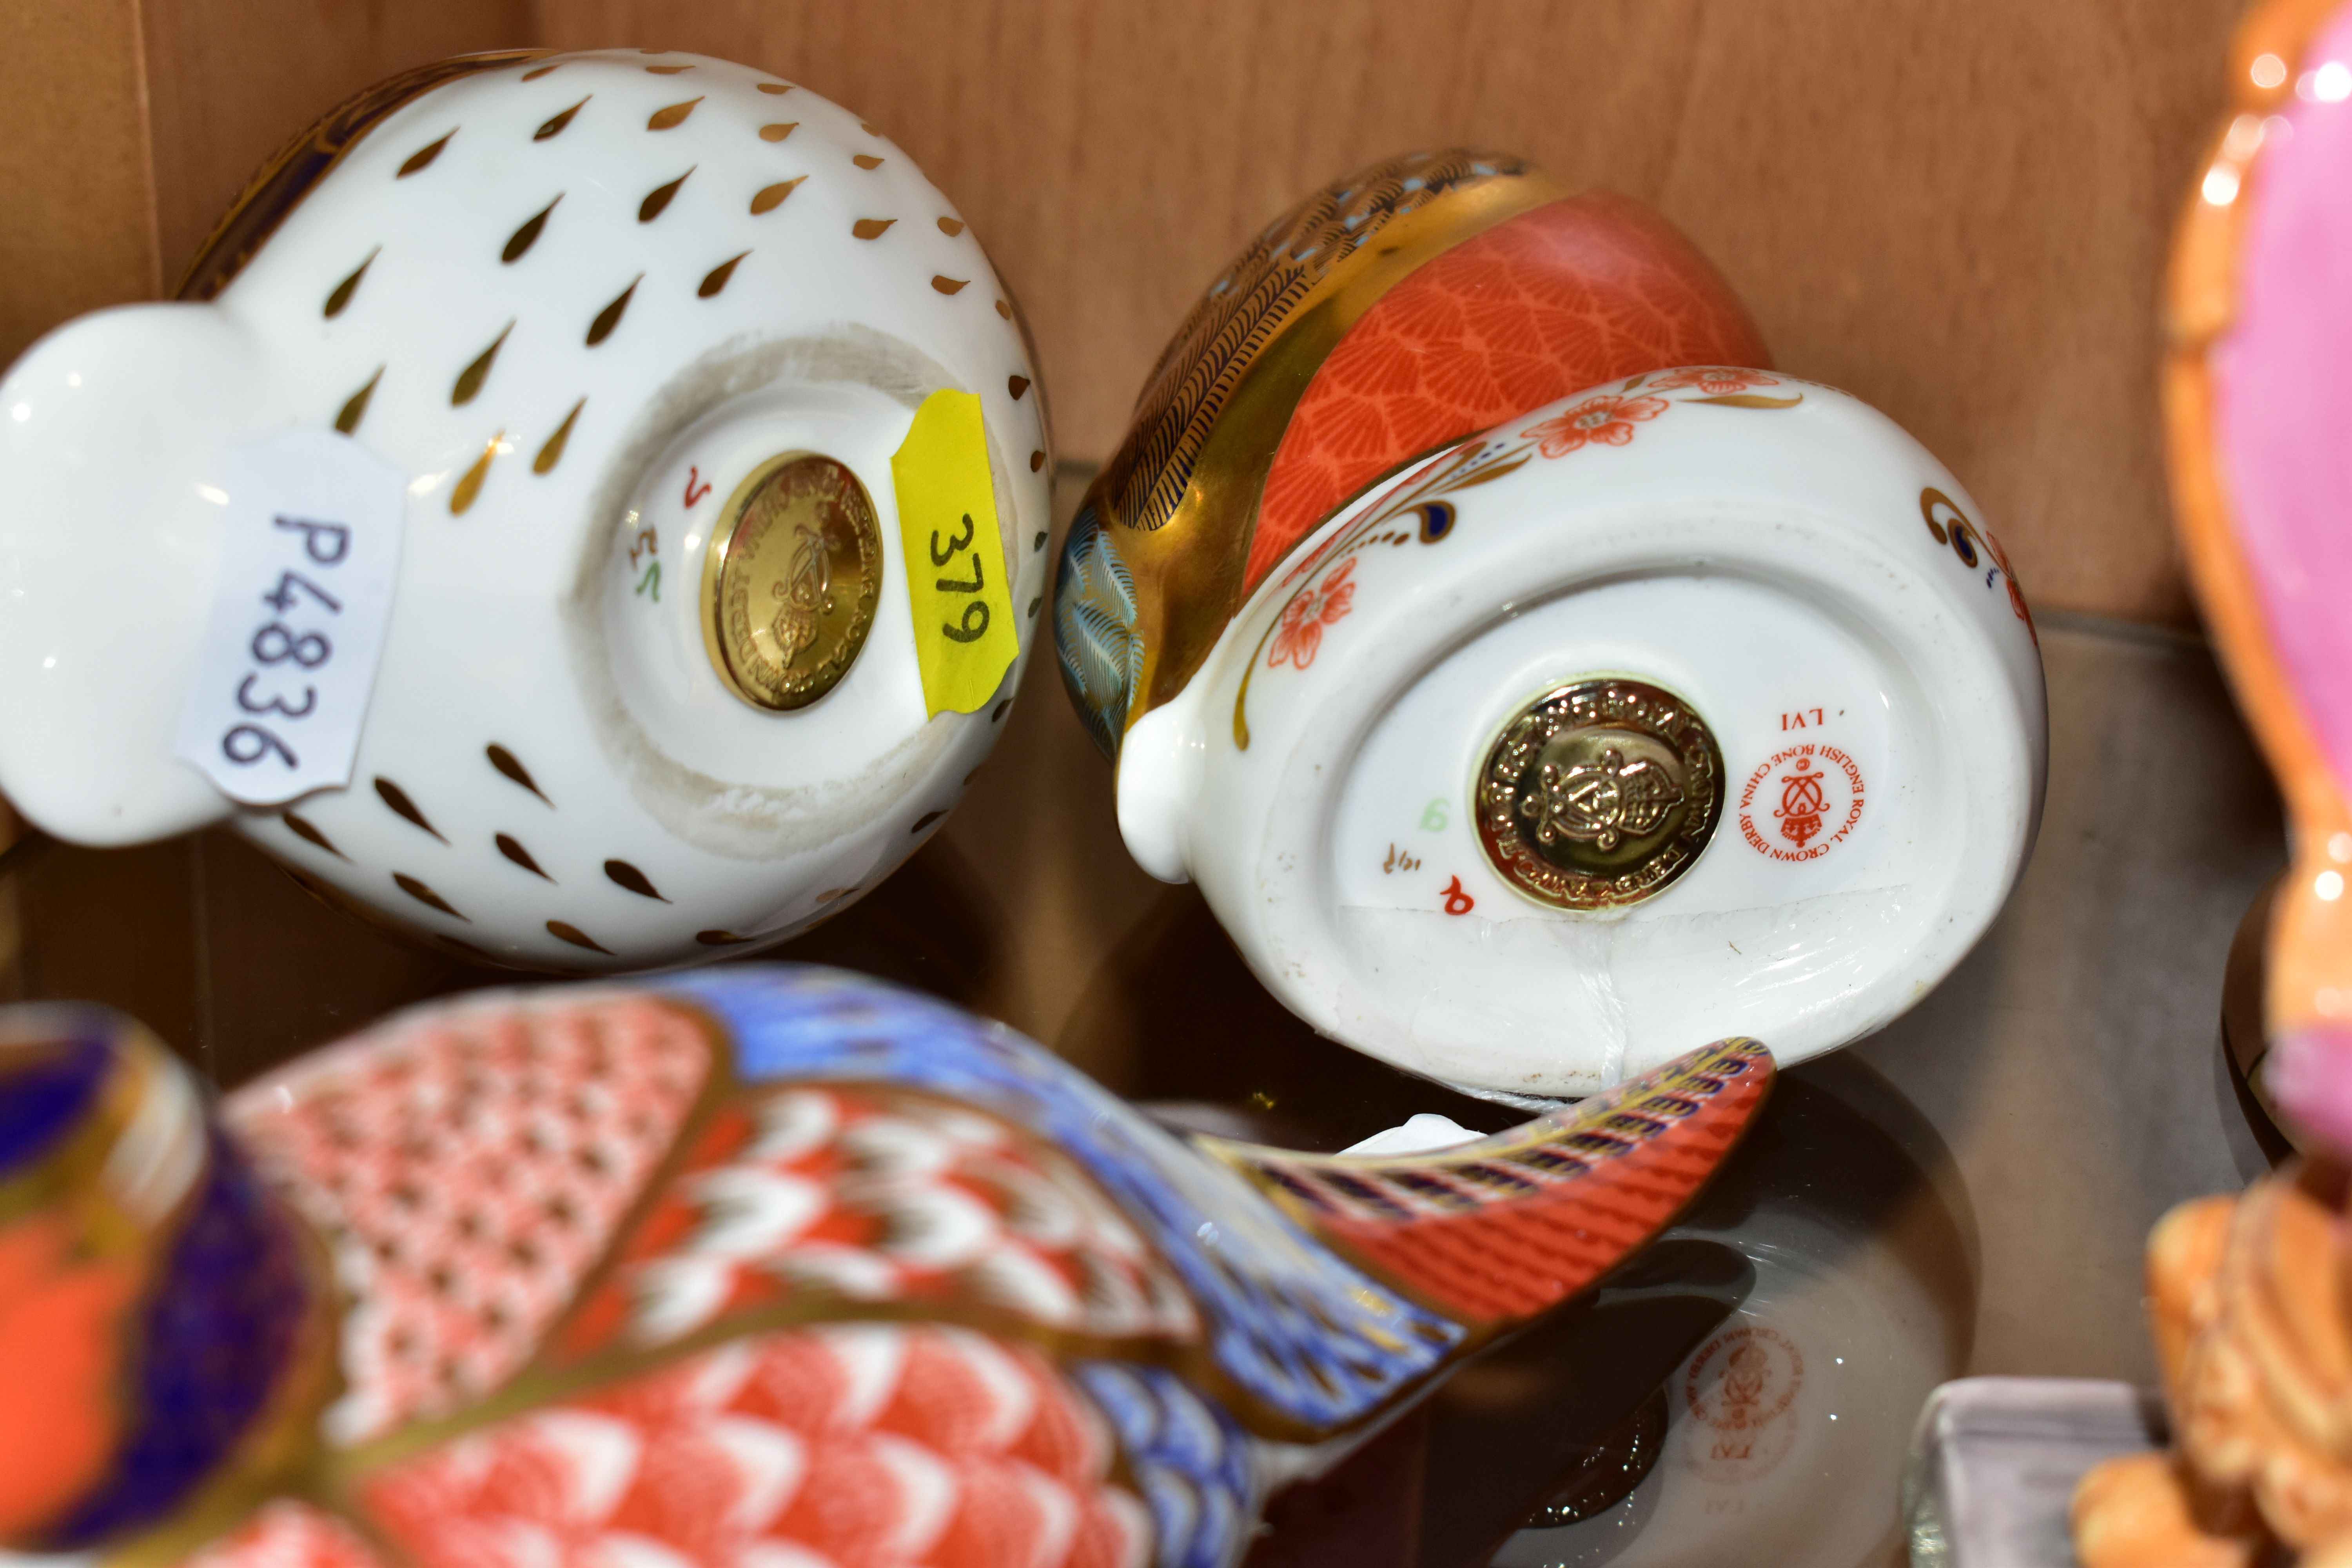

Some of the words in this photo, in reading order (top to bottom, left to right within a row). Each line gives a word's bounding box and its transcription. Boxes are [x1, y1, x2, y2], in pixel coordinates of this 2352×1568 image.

[931, 514, 990, 643] 379
[221, 514, 352, 771] P4836
[1782, 708, 1823, 731] LVI
[1771, 744, 1815, 766] BONE
[1820, 745, 1864, 794] ENGLISH
[1739, 763, 1771, 809] CHINA
[1739, 813, 1770, 854] DERBY
[1830, 799, 1864, 843] ROYAL
[1769, 844, 1829, 861] CROWN
